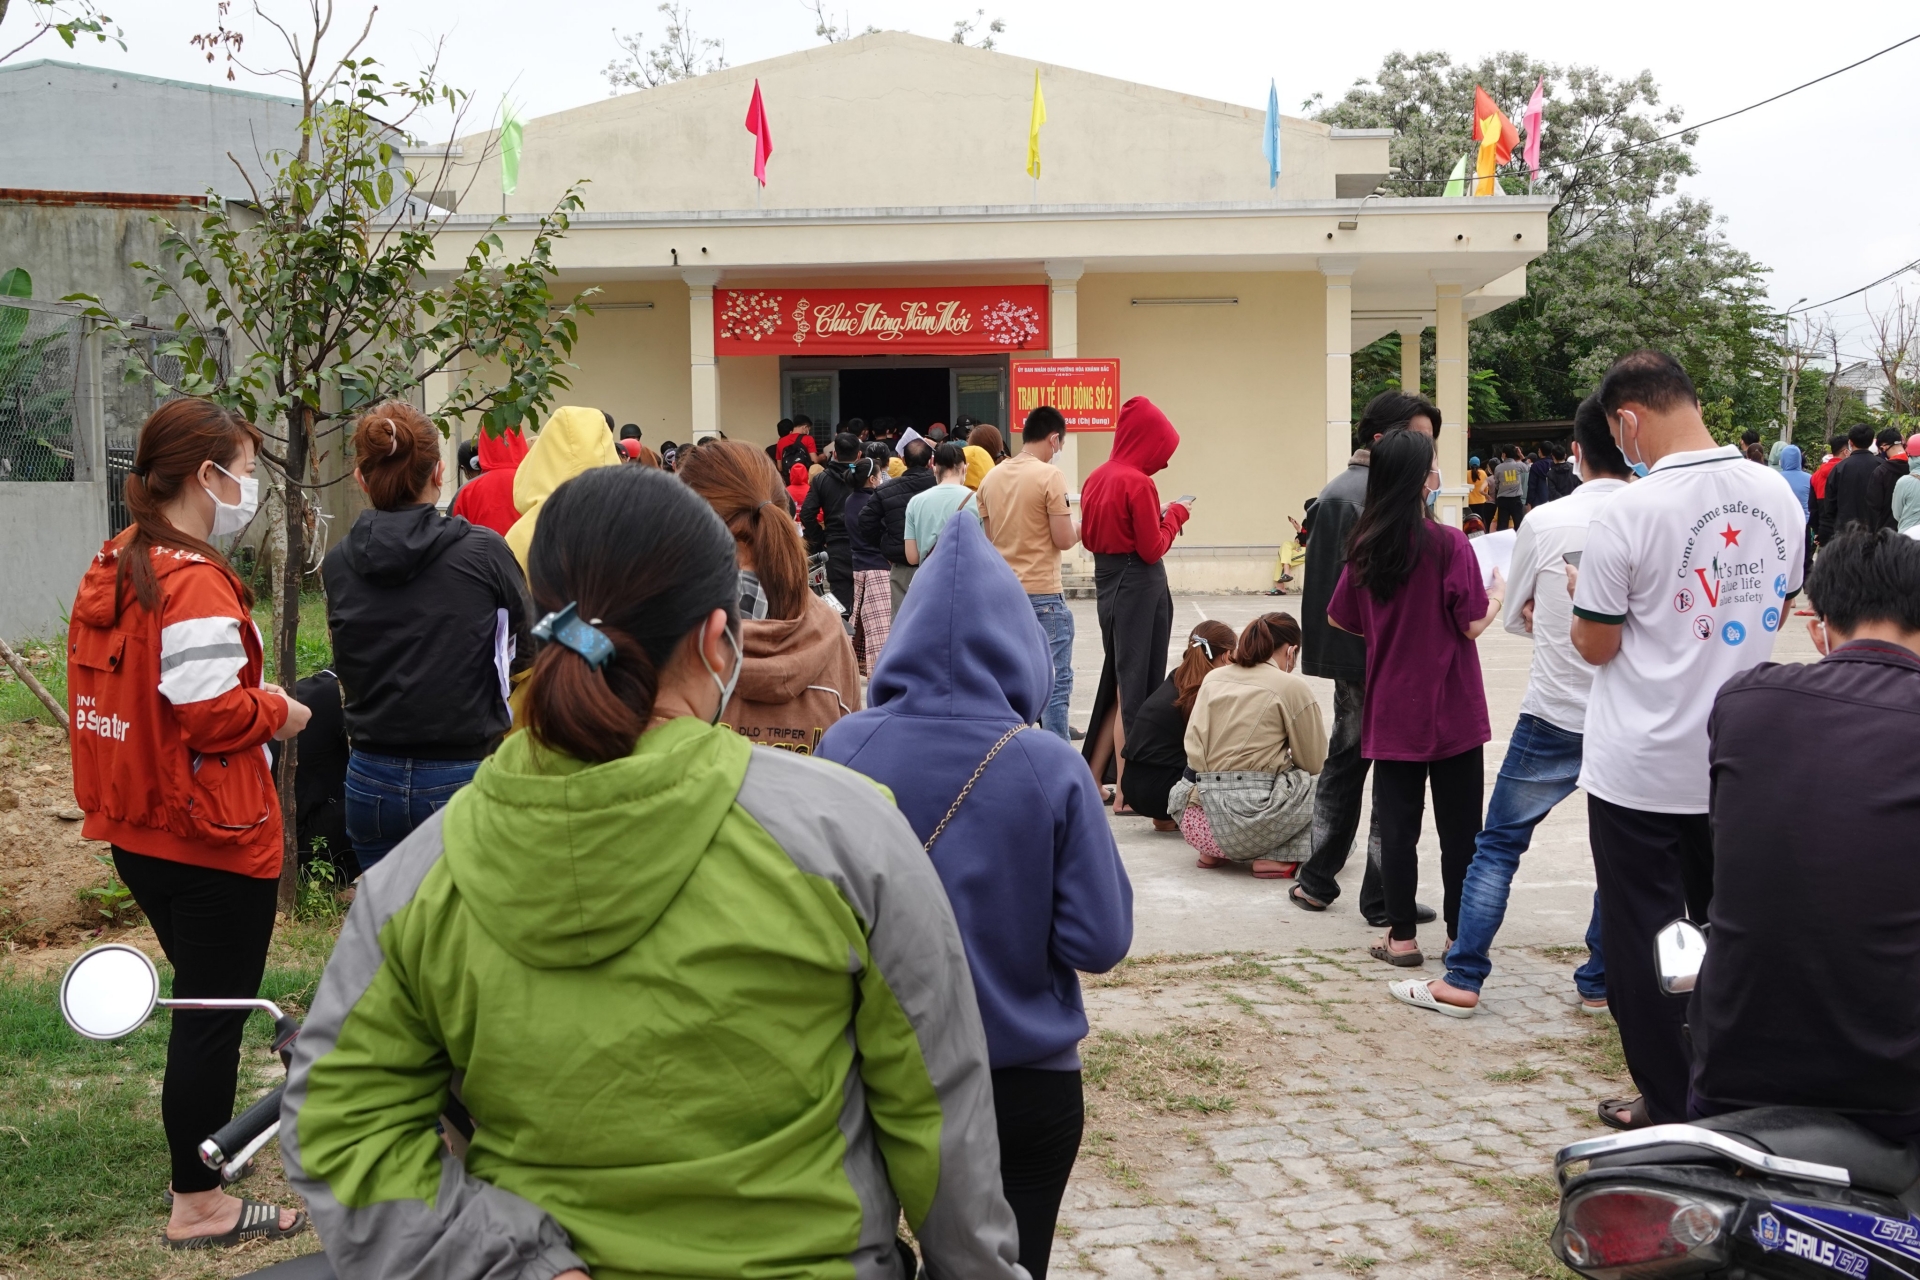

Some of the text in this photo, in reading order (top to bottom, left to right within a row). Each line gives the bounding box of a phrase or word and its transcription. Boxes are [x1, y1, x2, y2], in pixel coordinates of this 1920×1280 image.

[814, 300, 974, 341] Chúc Mừng Năm Mới
[1017, 377, 1113, 415] TRẠM Y TẾ LƯU ĐỘNG SỐ 2
[1092, 417, 1110, 425] Dung)
[1677, 500, 1787, 579] Come home safe everyday
[1735, 558, 1764, 576] me!
[1741, 576, 1762, 590] life
[1734, 592, 1764, 604] safety
[767, 726, 806, 739] TRIPER
[1870, 1216, 1918, 1243] GP
[1785, 1227, 1869, 1276] SIRIUS GP
